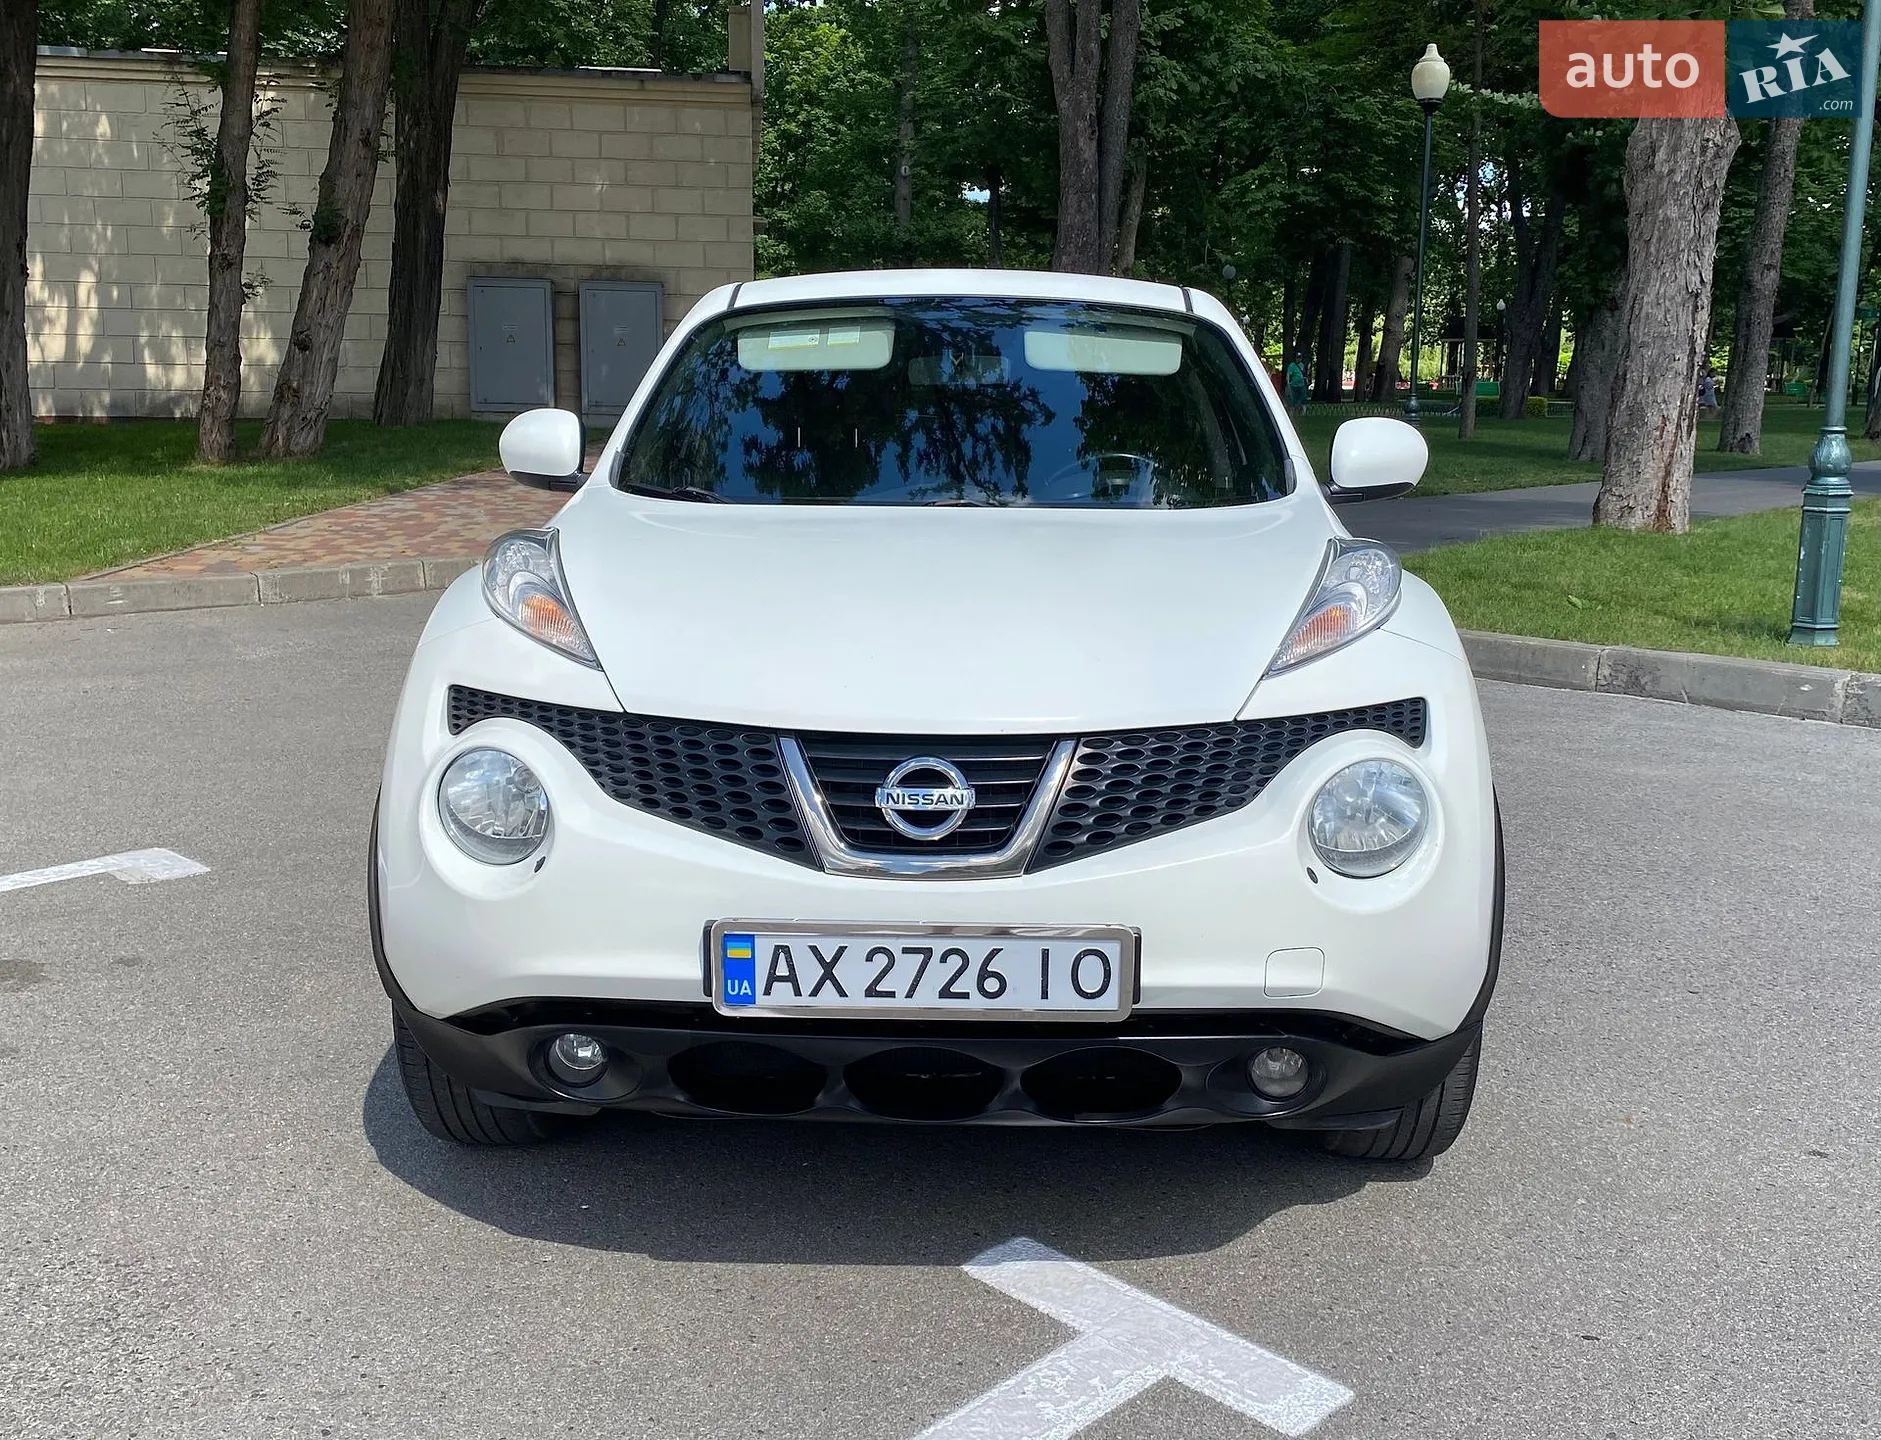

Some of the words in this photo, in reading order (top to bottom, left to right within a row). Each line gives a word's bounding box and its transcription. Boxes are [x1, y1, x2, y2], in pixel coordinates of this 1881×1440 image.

[886, 793, 964, 805] NISSAN
[762, 944, 849, 999] AX
[864, 946, 1008, 1000] 2726
[727, 979, 753, 996] UA
